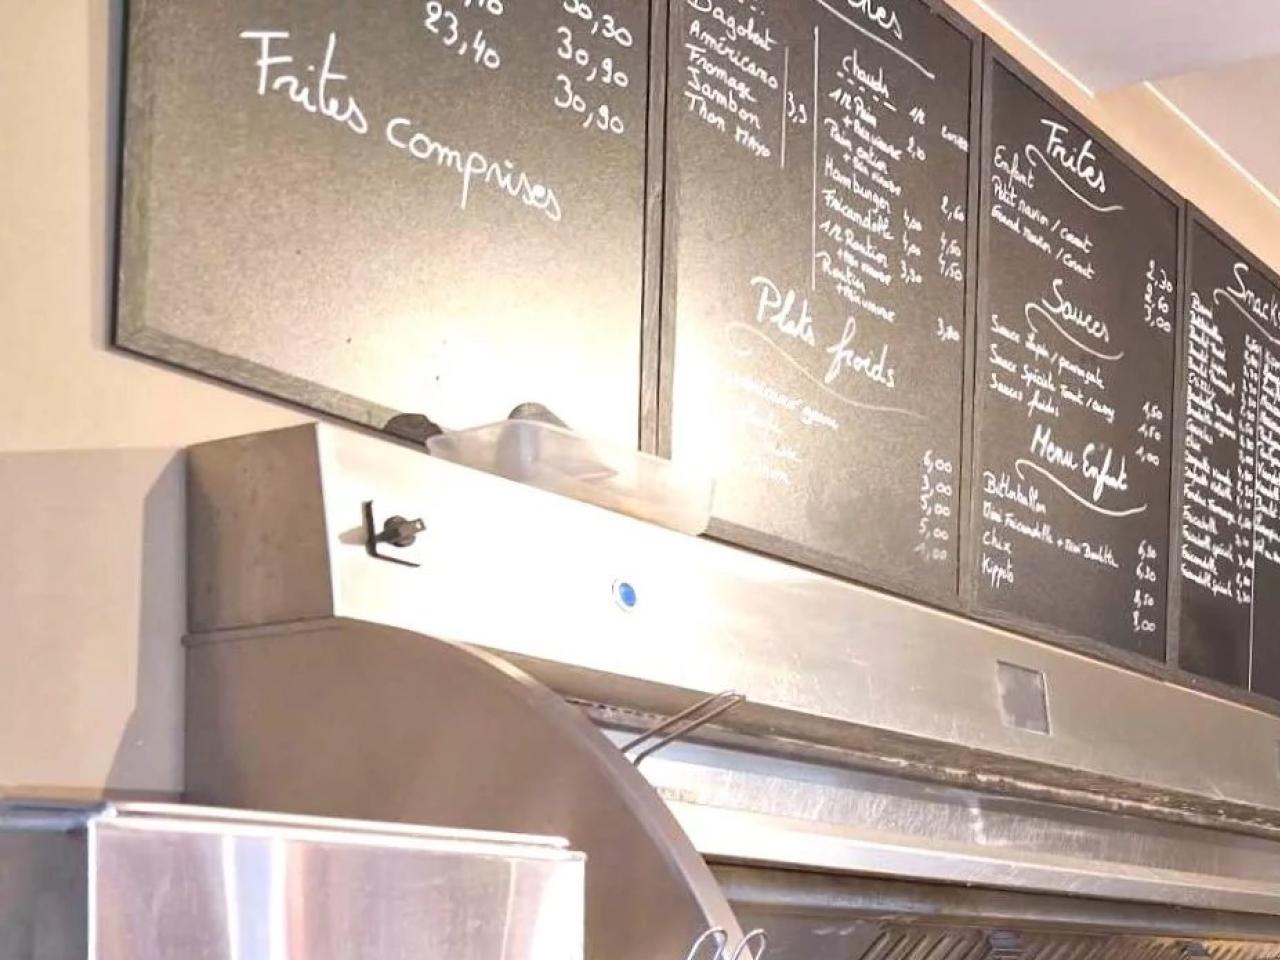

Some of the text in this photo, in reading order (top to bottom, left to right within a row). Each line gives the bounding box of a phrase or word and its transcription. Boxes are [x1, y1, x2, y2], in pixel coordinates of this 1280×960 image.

[425, 1, 500, 68] 23,40
[557, 26, 629, 87] 30,90
[239, 31, 368, 134] Frites
[554, 74, 624, 134] 30,90
[684, 91, 725, 132] Thon
[688, 66, 760, 129] Jambon
[1040, 118, 1106, 193] Frites
[751, 276, 894, 388] Plats froids
[1042, 278, 1109, 342] Sauces
[923, 449, 953, 473] 6,00
[1030, 423, 1128, 501] Menu Enfant
[919, 517, 949, 540] 5,00
[920, 494, 951, 516] 5,00
